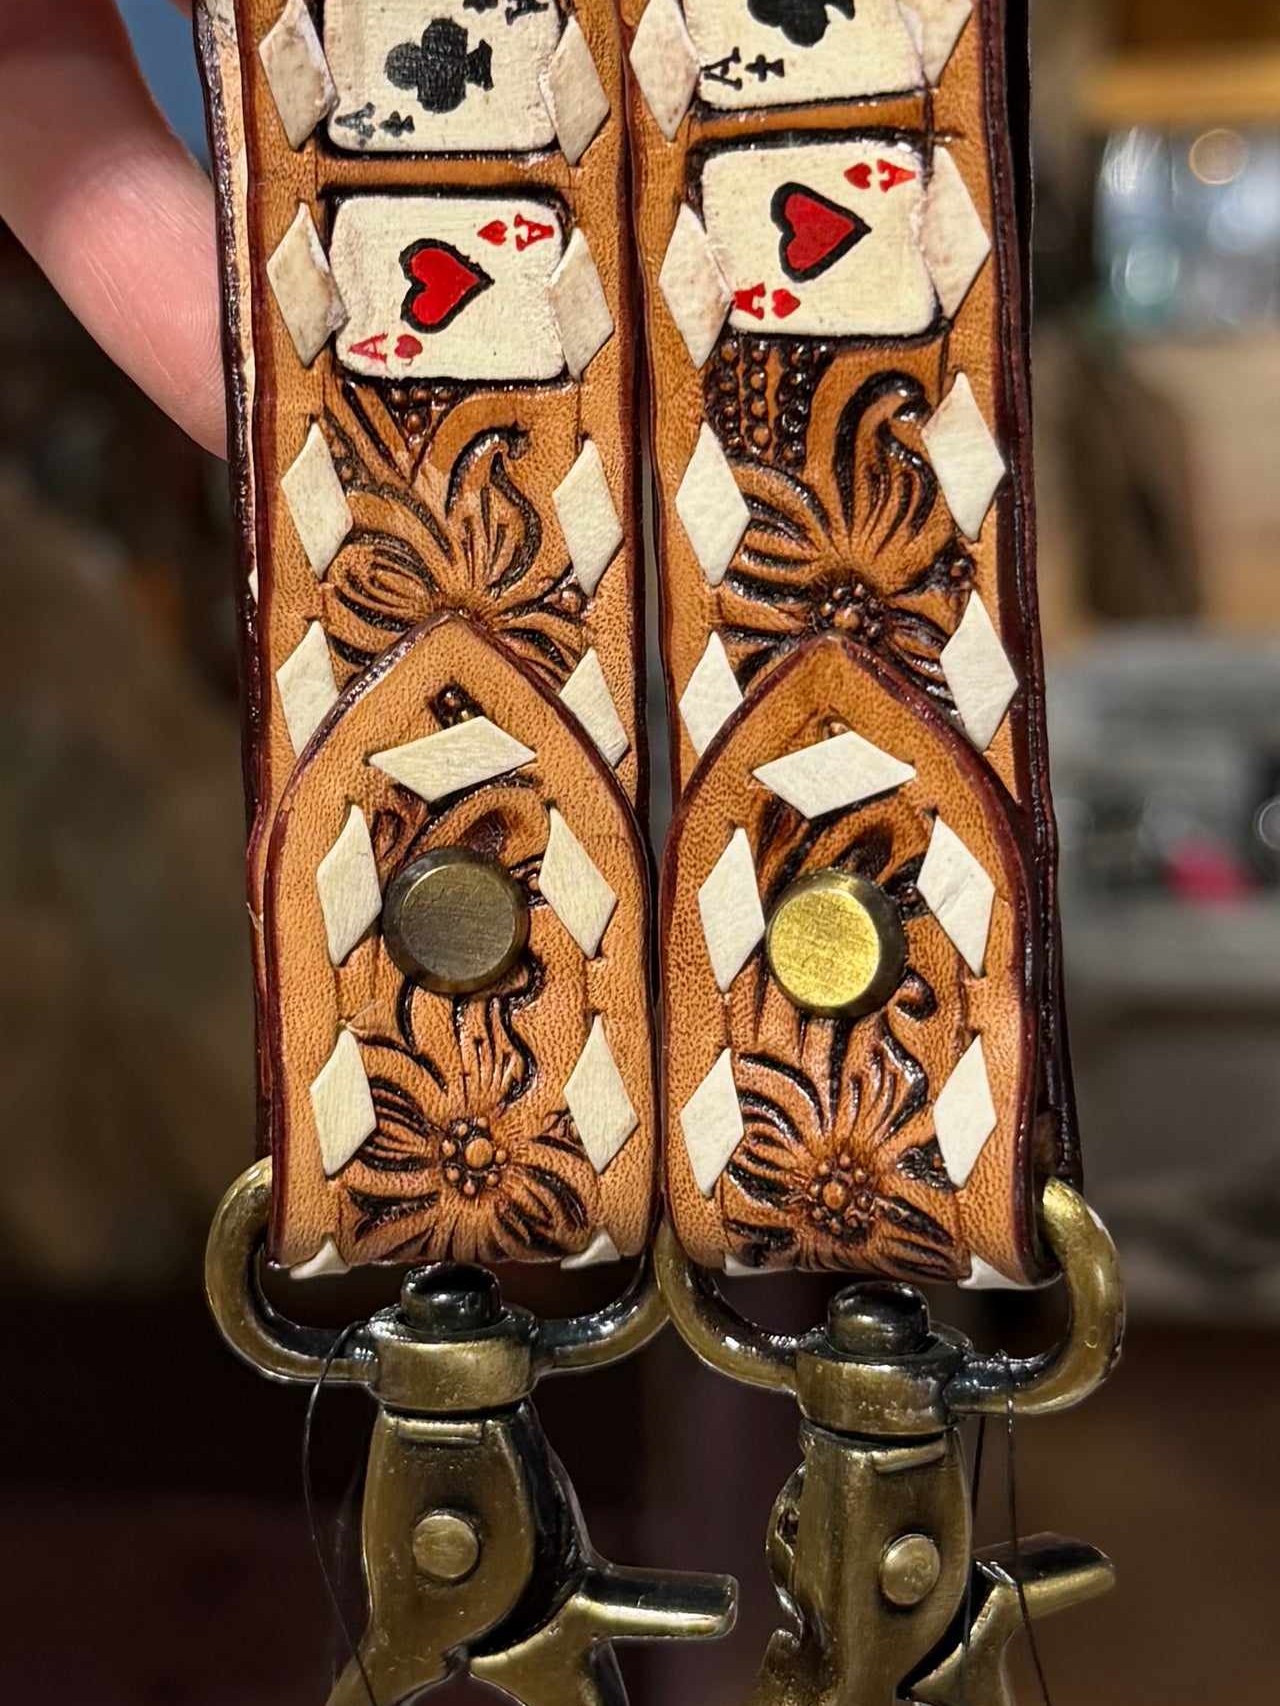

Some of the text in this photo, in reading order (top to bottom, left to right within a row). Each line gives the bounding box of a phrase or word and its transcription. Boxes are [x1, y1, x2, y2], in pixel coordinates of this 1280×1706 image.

[700, 47, 742, 90] A
[334, 102, 376, 147] A
[877, 160, 916, 192] A
[514, 214, 554, 251] A
[734, 284, 765, 319] A
[349, 333, 388, 364] A
